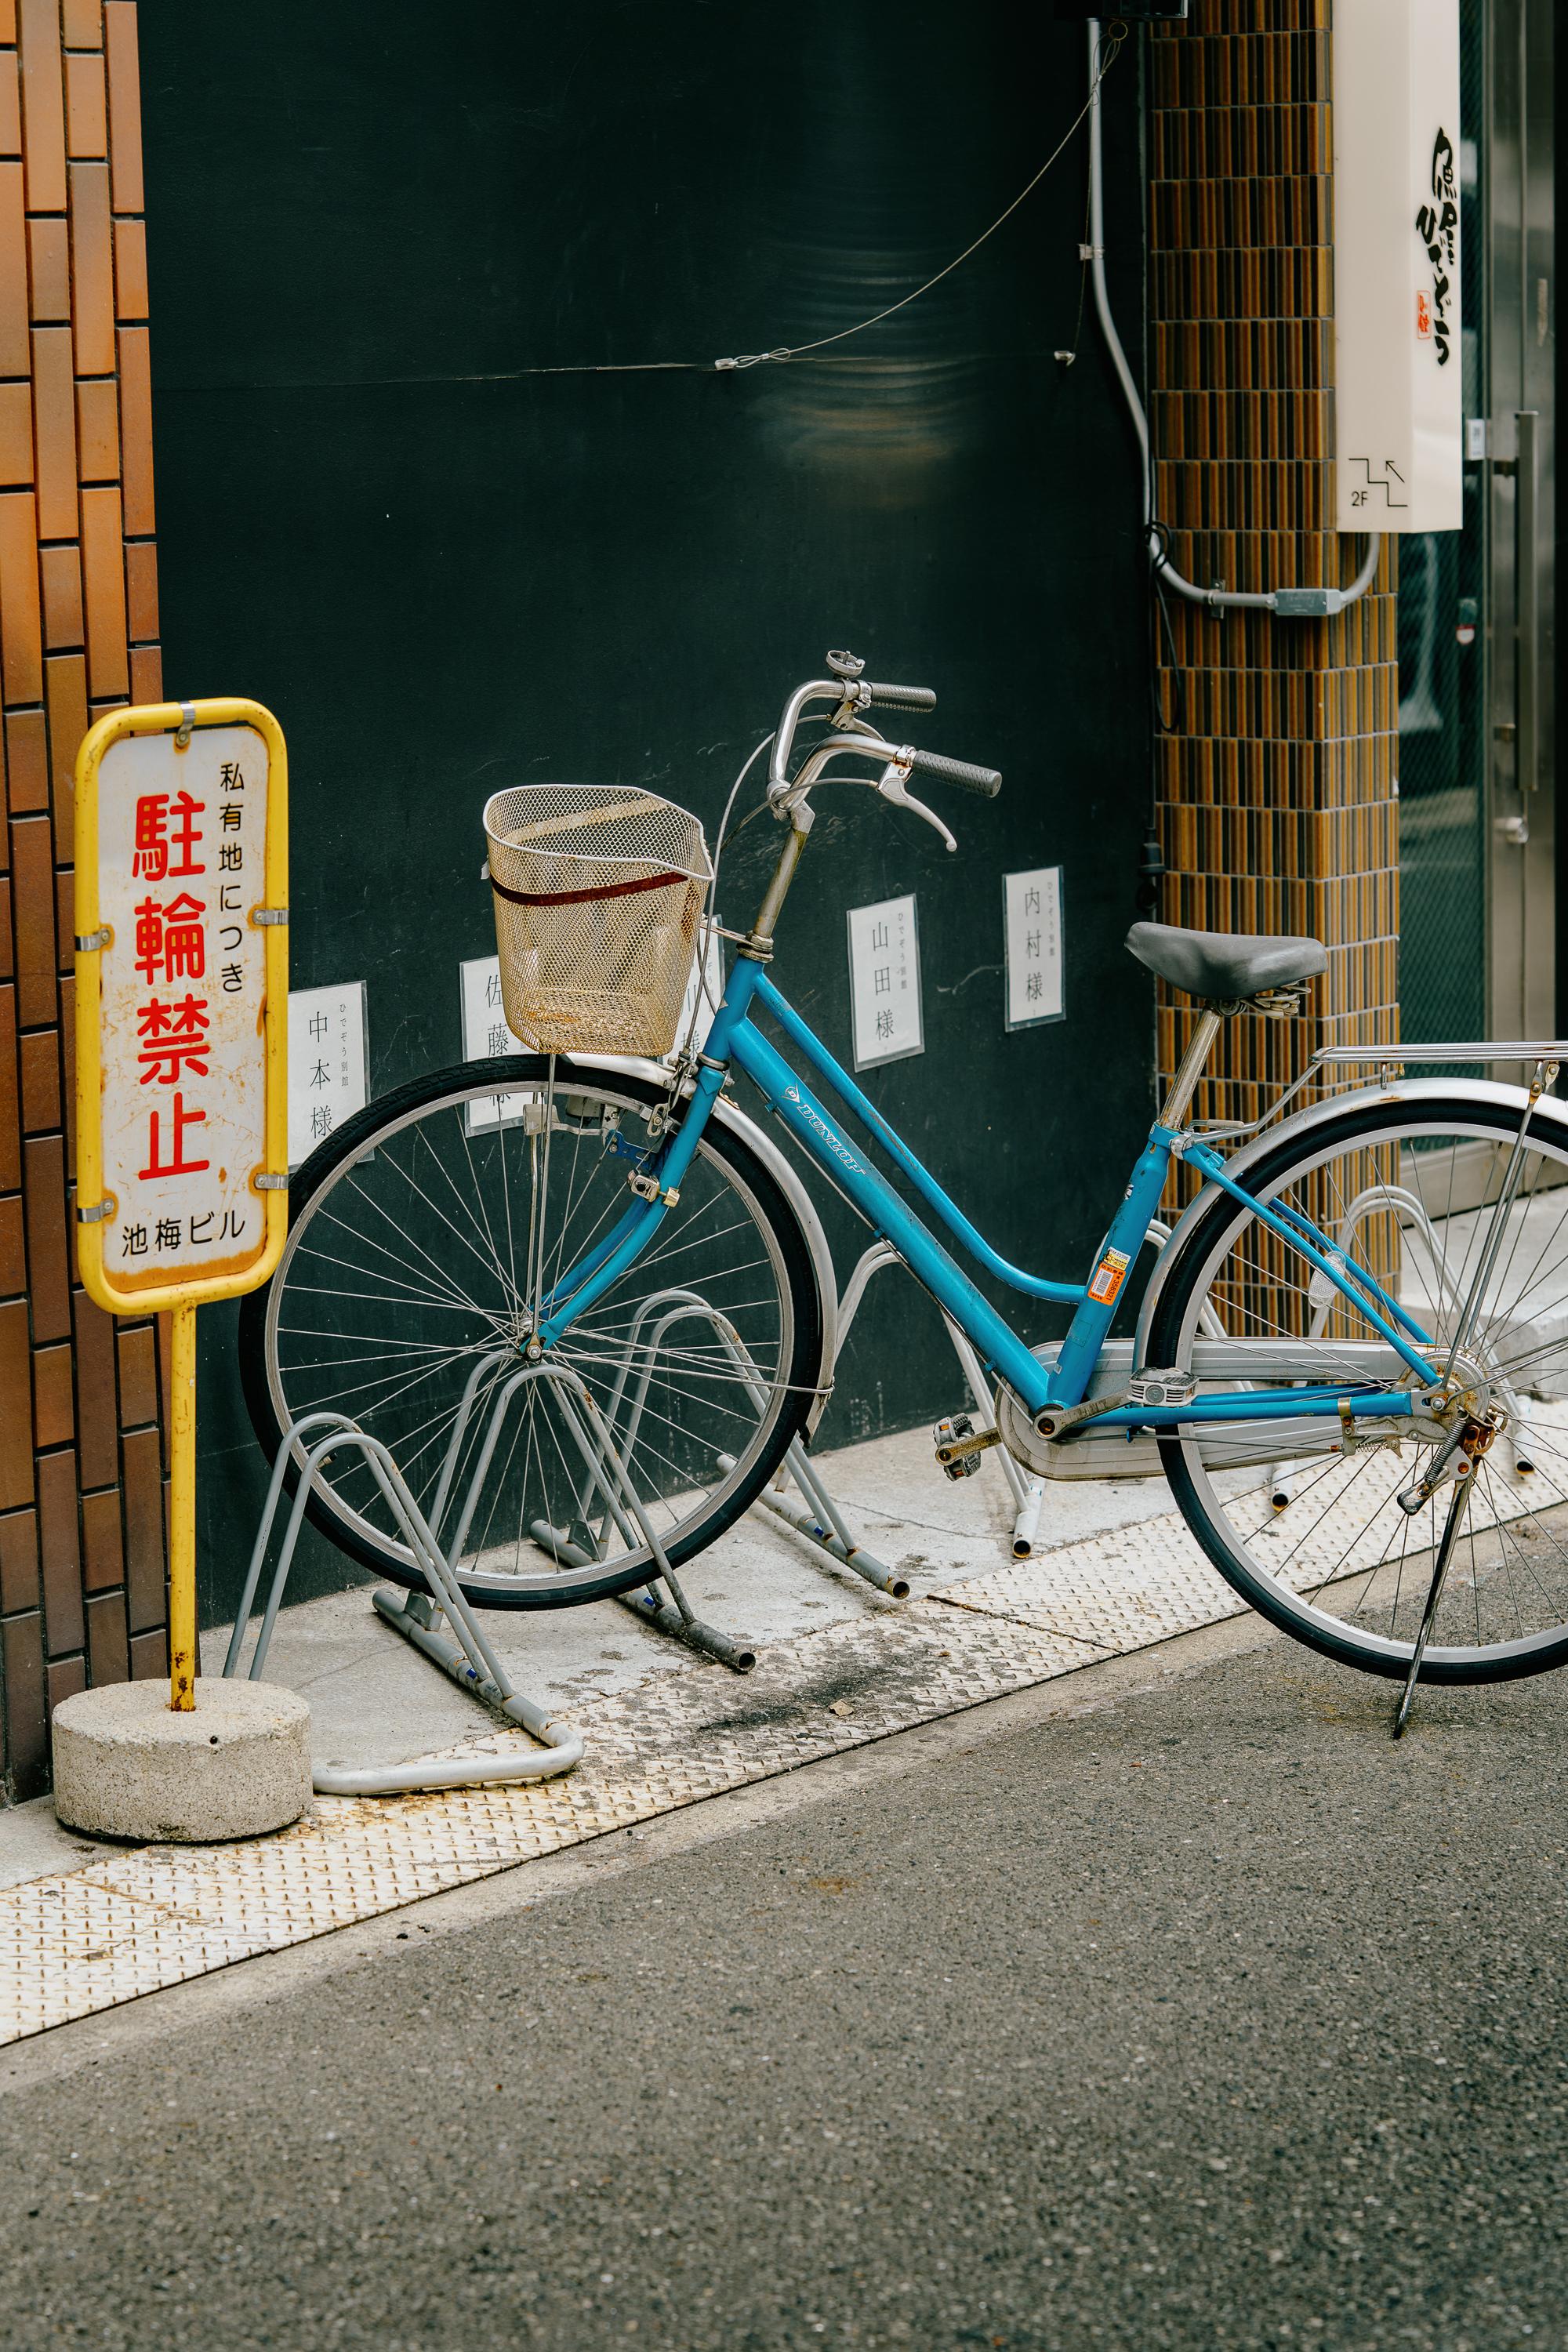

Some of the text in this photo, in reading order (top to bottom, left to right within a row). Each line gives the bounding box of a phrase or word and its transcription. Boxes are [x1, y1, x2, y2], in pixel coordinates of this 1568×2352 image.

[1351, 491, 1368, 506] 2F
[219, 762, 245, 993] 私有地につき
[132, 790, 210, 1181] 駐輪禁止
[873, 921, 895, 1041] 山田様
[1025, 887, 1043, 1002] 内村様
[309, 1011, 332, 1139] 中本様
[339, 1003, 349, 1087] ひでぞう別館
[485, 974, 510, 1106] 佐藤
[797, 1104, 866, 1174] DUNLOP
[122, 1209, 245, 1258] 池梅ビル
